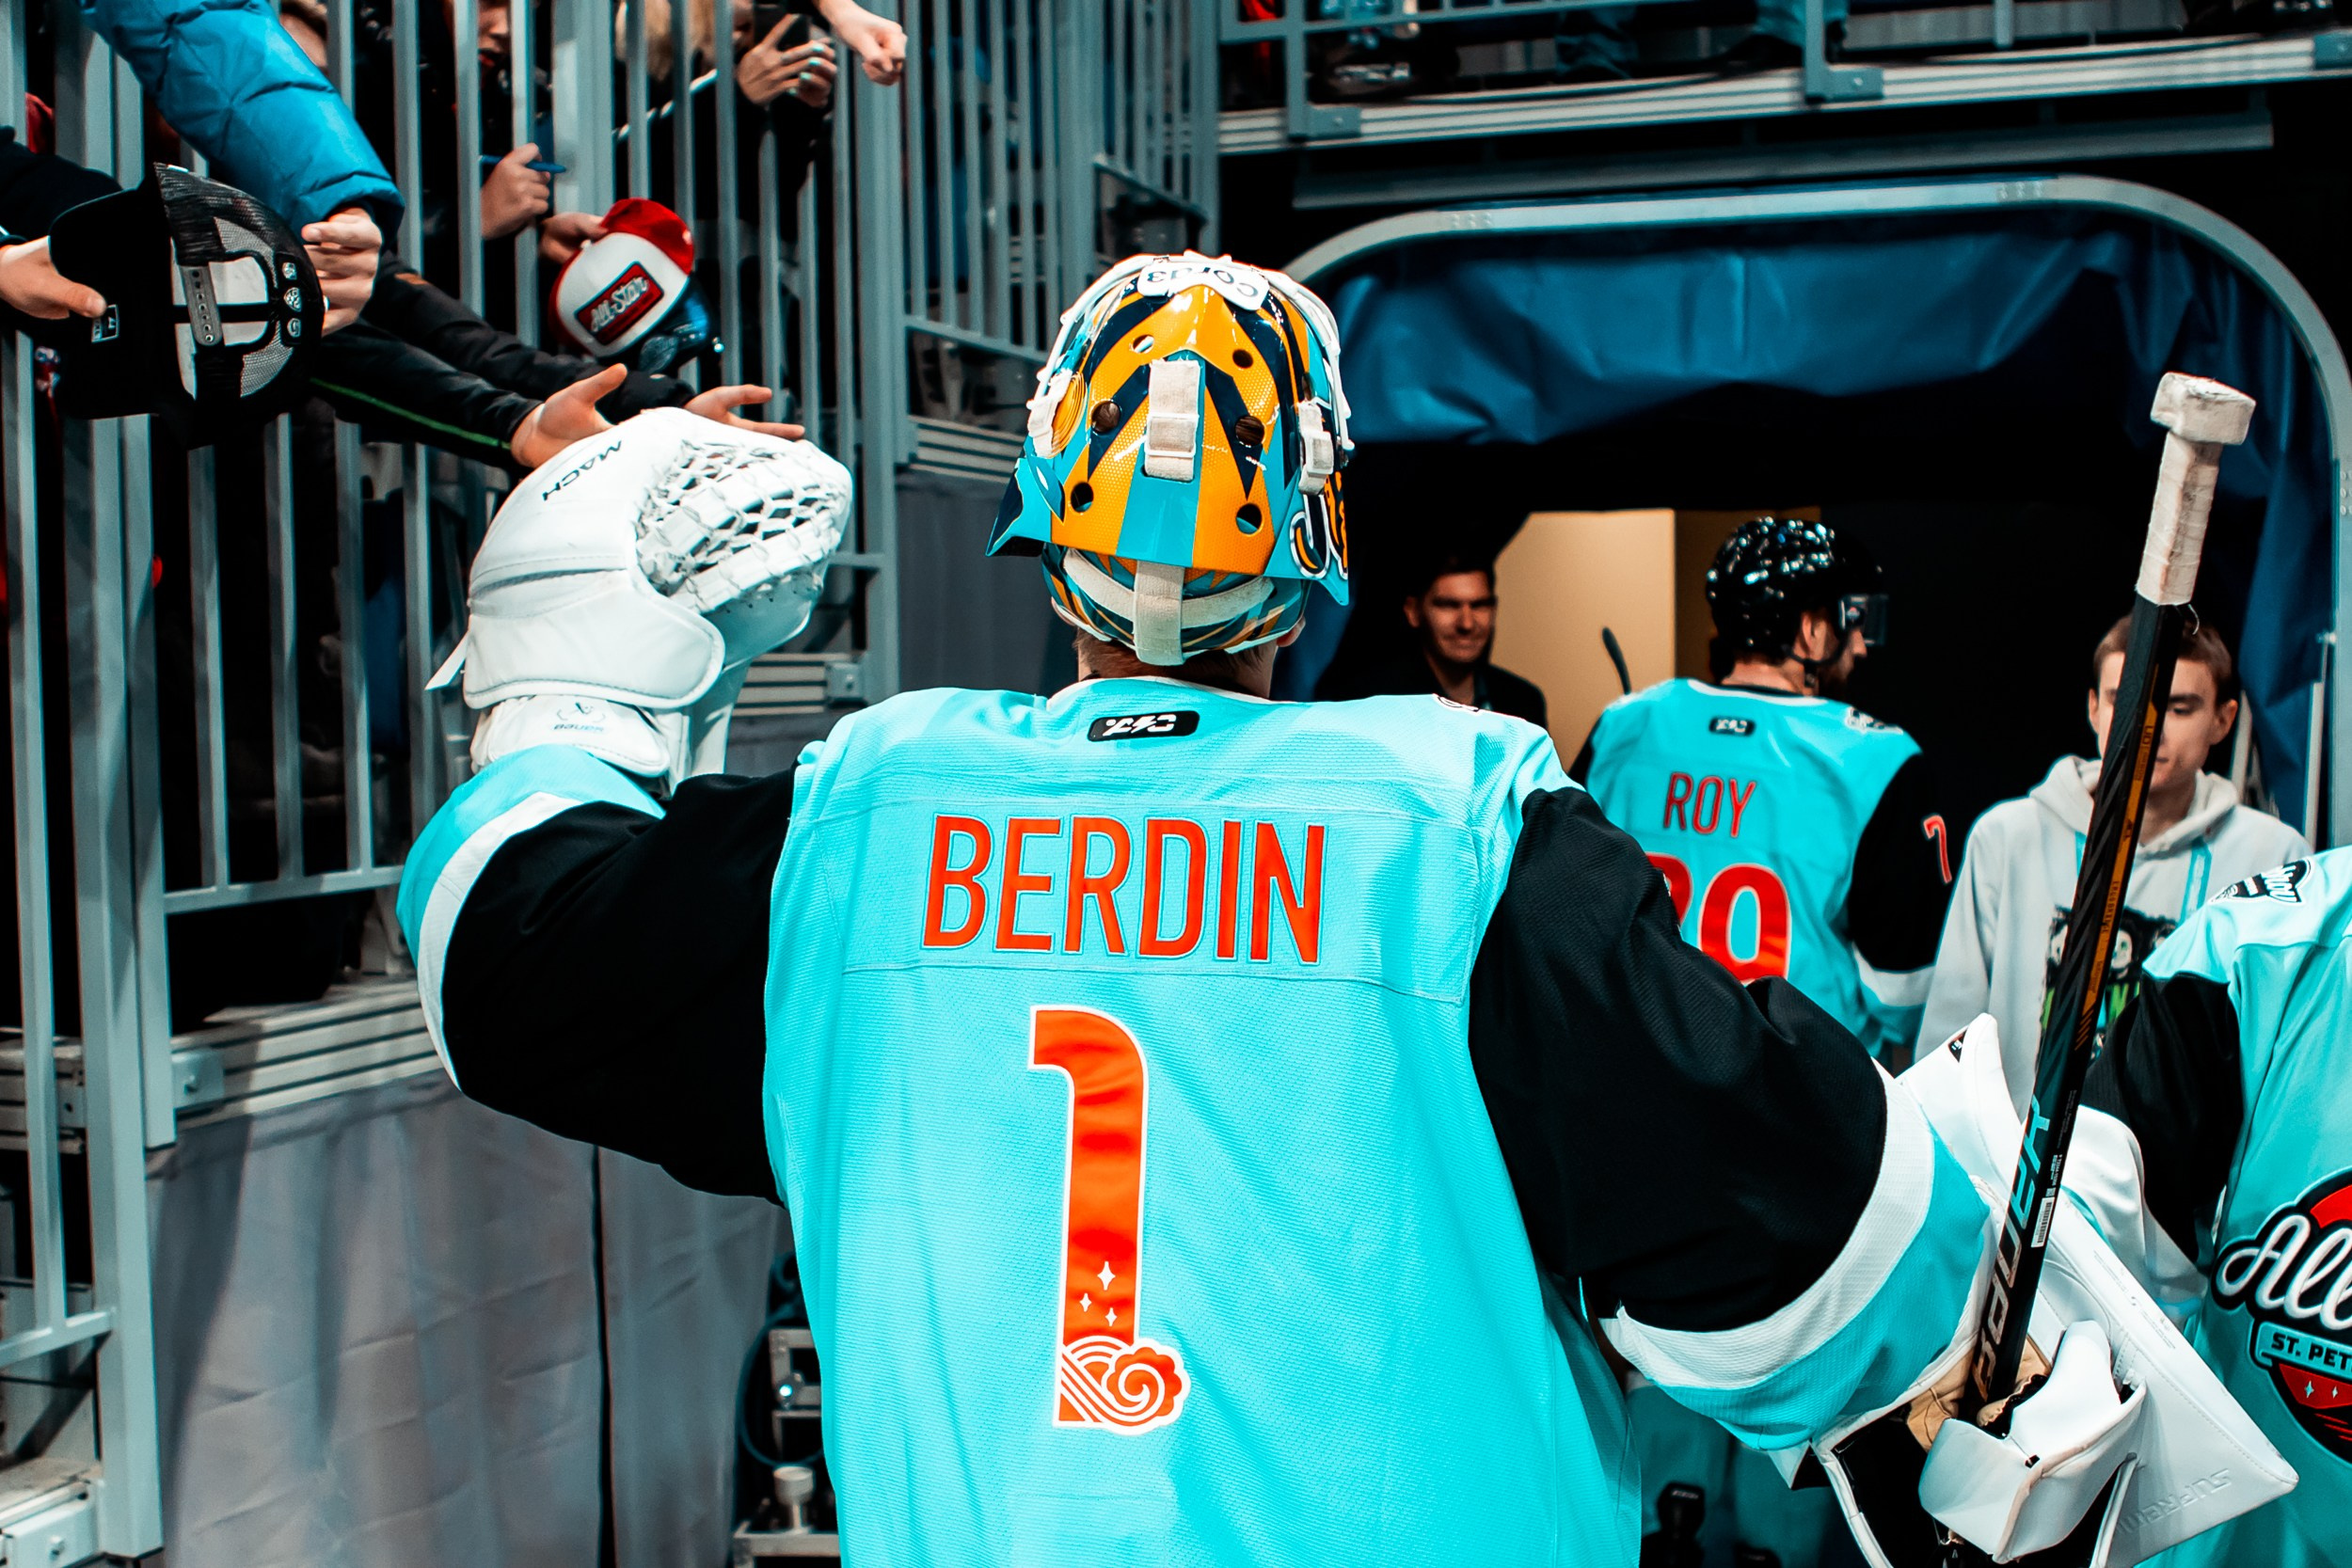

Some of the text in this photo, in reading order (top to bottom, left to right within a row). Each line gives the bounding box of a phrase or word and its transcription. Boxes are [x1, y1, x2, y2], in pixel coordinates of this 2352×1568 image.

[591, 276, 649, 333] All-Star
[542, 439, 622, 501] MACH
[1663, 771, 1756, 838] ROY
[922, 815, 1327, 964] BERDIN
[1028, 1005, 1190, 1436] 1
[2271, 1332, 2352, 1372] ST. PET
[2117, 1468, 2233, 1533] SUPREM
